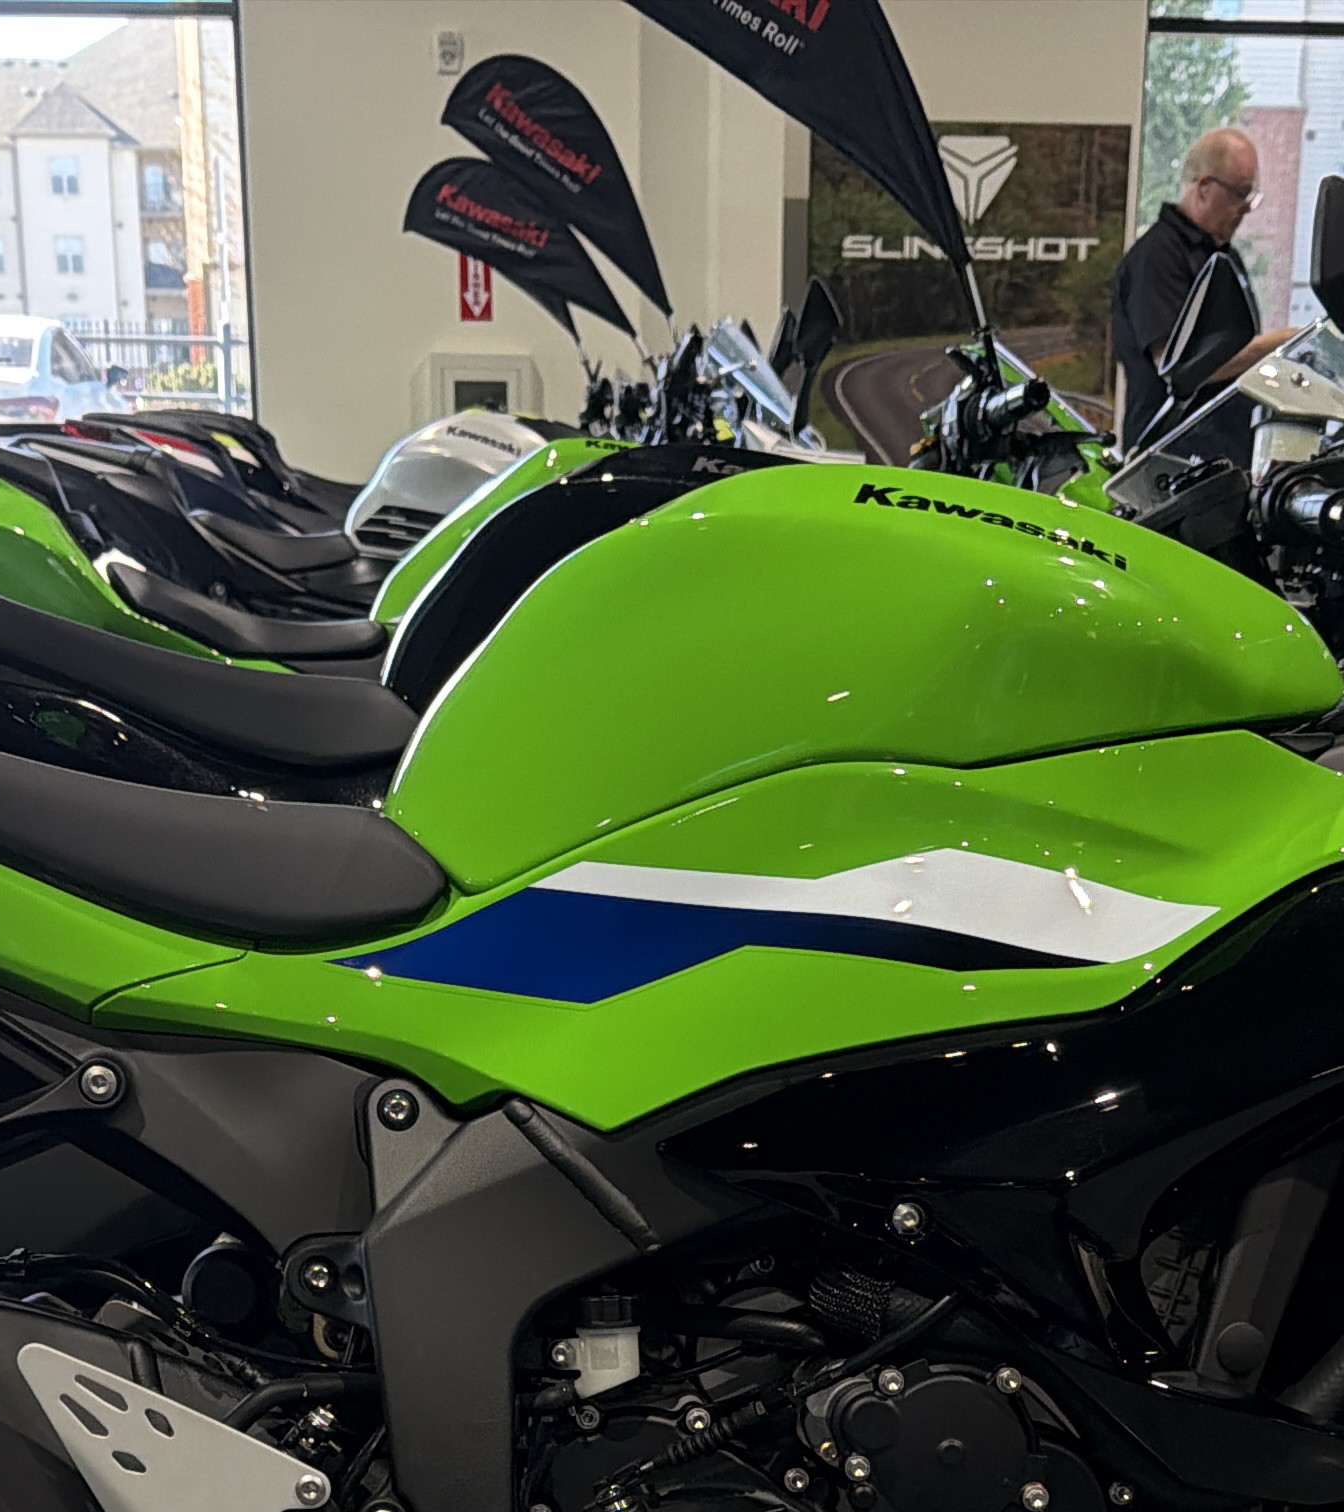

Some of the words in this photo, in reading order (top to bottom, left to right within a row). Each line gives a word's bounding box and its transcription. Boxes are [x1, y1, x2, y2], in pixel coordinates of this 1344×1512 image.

[713, 0, 762, 32] imes
[762, 21, 800, 56] Roll
[485, 81, 603, 185] Kawasaki
[437, 183, 550, 248] Kawasaki
[842, 235, 1100, 261] SLINSHOT
[853, 483, 1127, 571] Kawasaki
